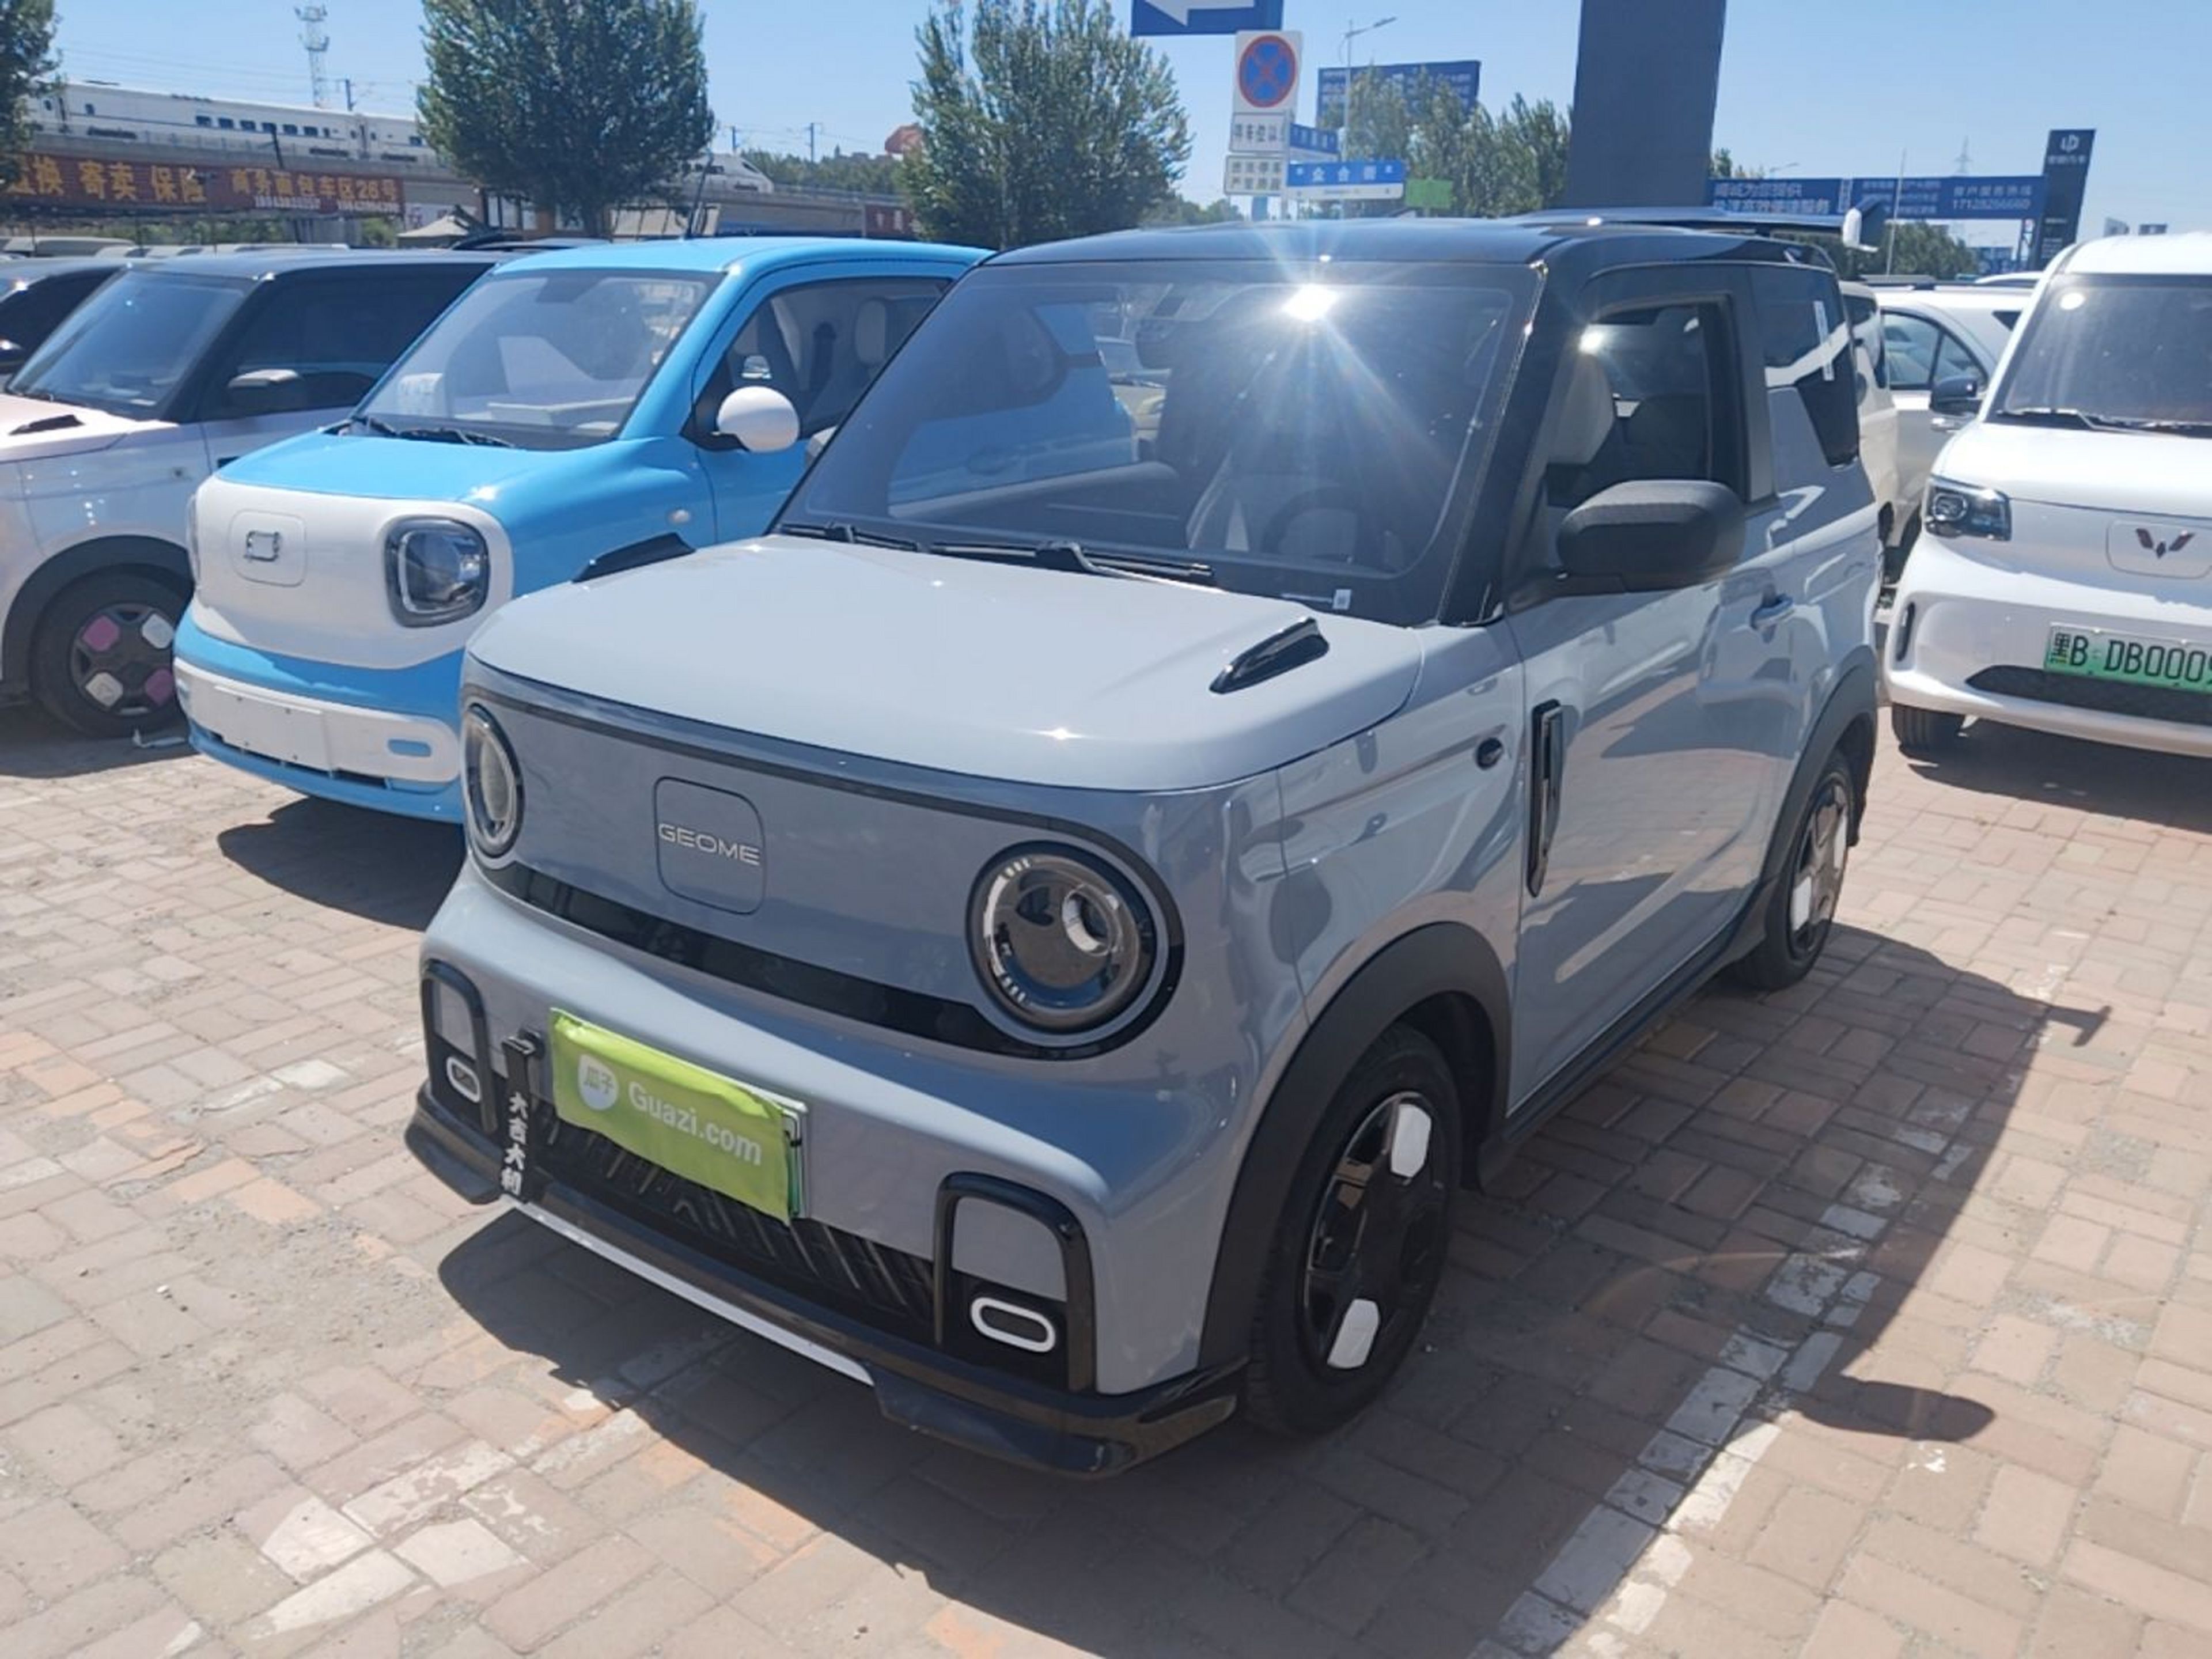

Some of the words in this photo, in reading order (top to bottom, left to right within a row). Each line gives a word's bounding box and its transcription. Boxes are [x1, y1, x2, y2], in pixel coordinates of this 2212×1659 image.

[78, 160, 137, 200] 寄卖
[151, 164, 207, 203] 保险
[658, 823, 760, 866] GEOME
[583, 1065, 615, 1096] 瓜子
[501, 1090, 529, 1196] 大吉大利
[628, 1081, 762, 1166] Guazi.com
